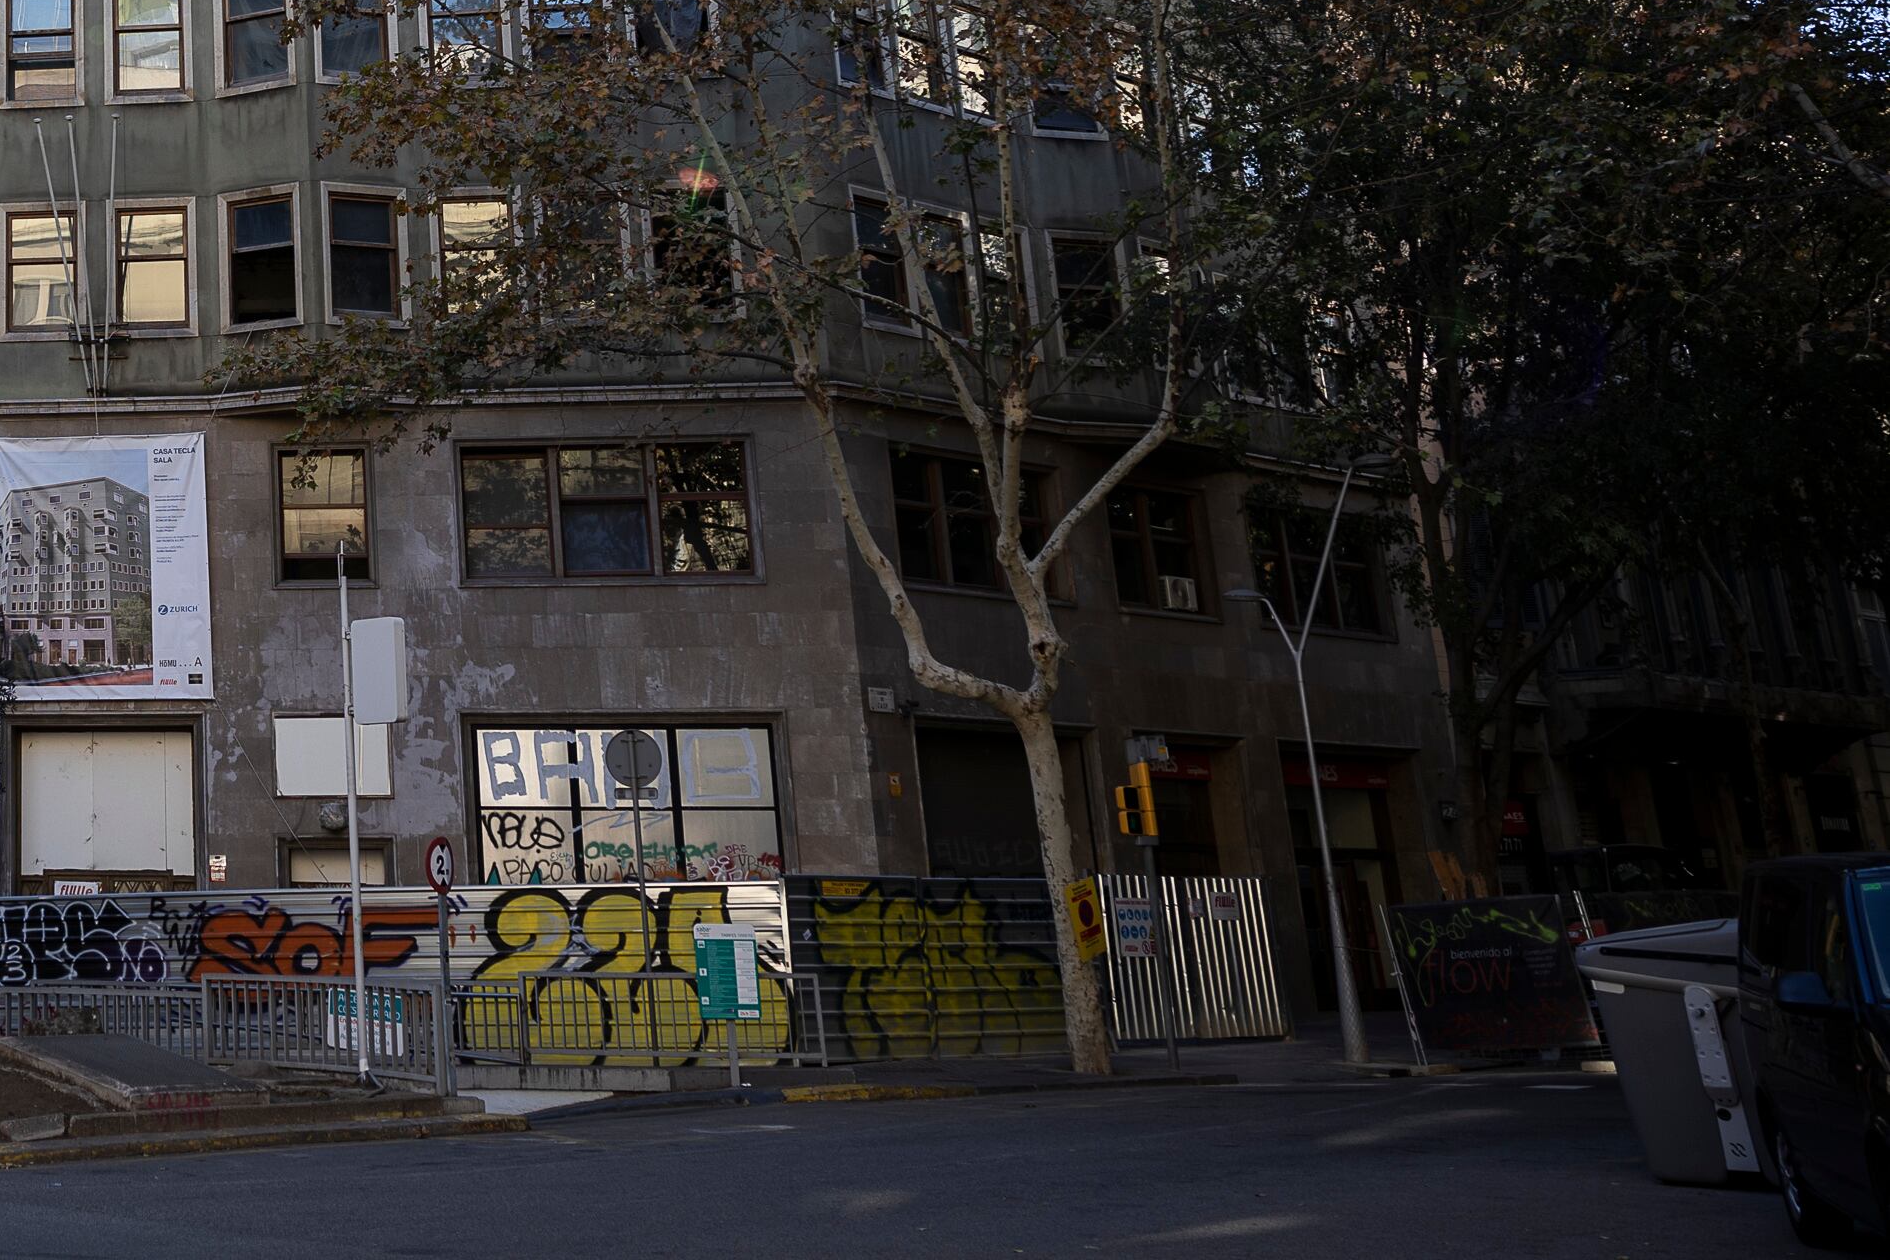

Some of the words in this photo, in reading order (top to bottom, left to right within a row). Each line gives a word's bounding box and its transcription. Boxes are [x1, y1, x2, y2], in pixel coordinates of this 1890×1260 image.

[173, 446, 196, 454] TECLA
[153, 456, 173, 464] SALA
[170, 605, 198, 613] ZURICH
[1422, 946, 1512, 1008] flow
